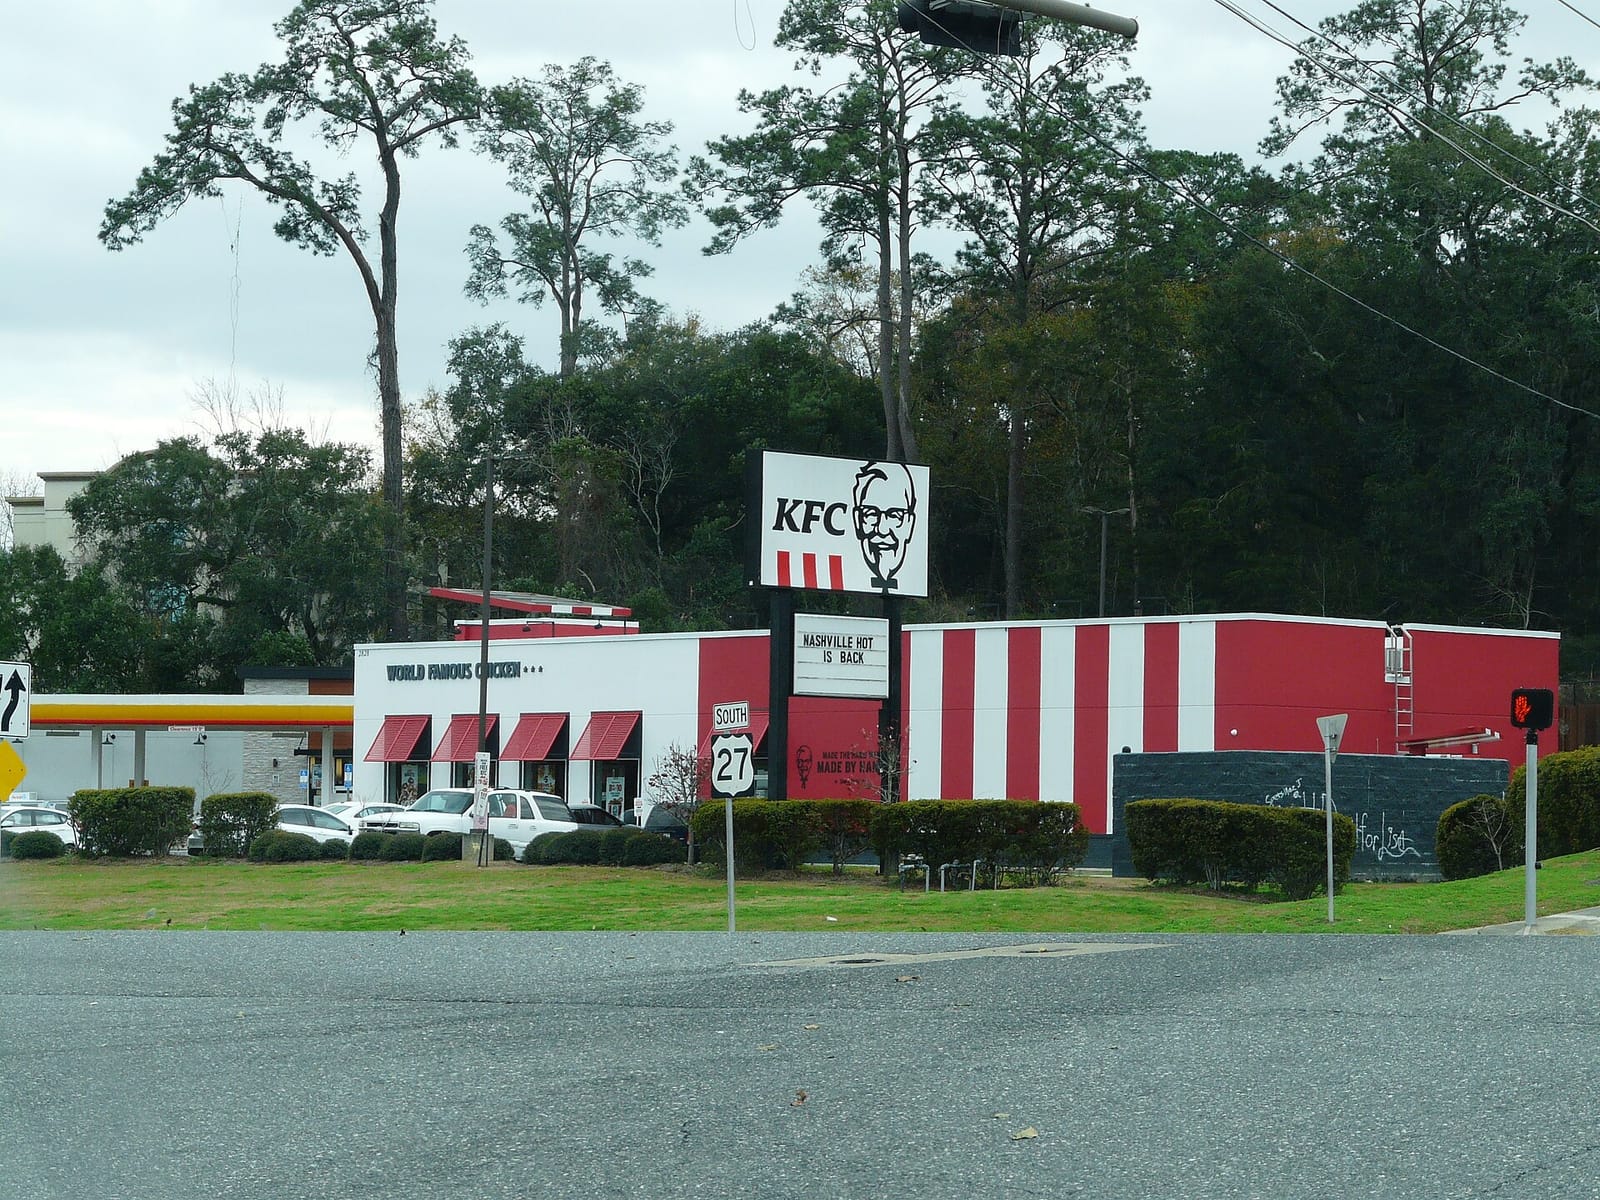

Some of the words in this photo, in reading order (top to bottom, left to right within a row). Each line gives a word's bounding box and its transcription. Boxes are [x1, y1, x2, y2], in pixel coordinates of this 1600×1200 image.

[772, 498, 848, 536] KFC
[803, 634, 853, 649] NASHVILLE
[856, 637, 874, 650] HOT
[823, 650, 832, 663] IS
[840, 651, 864, 664] BACK
[386, 664, 426, 681] WORLD
[428, 663, 473, 681] FAMOUS
[474, 661, 521, 680] CICKEN
[716, 707, 747, 725] SOUTH
[717, 748, 748, 781] 27
[817, 761, 842, 773] MADE
[845, 761, 857, 773] BY
